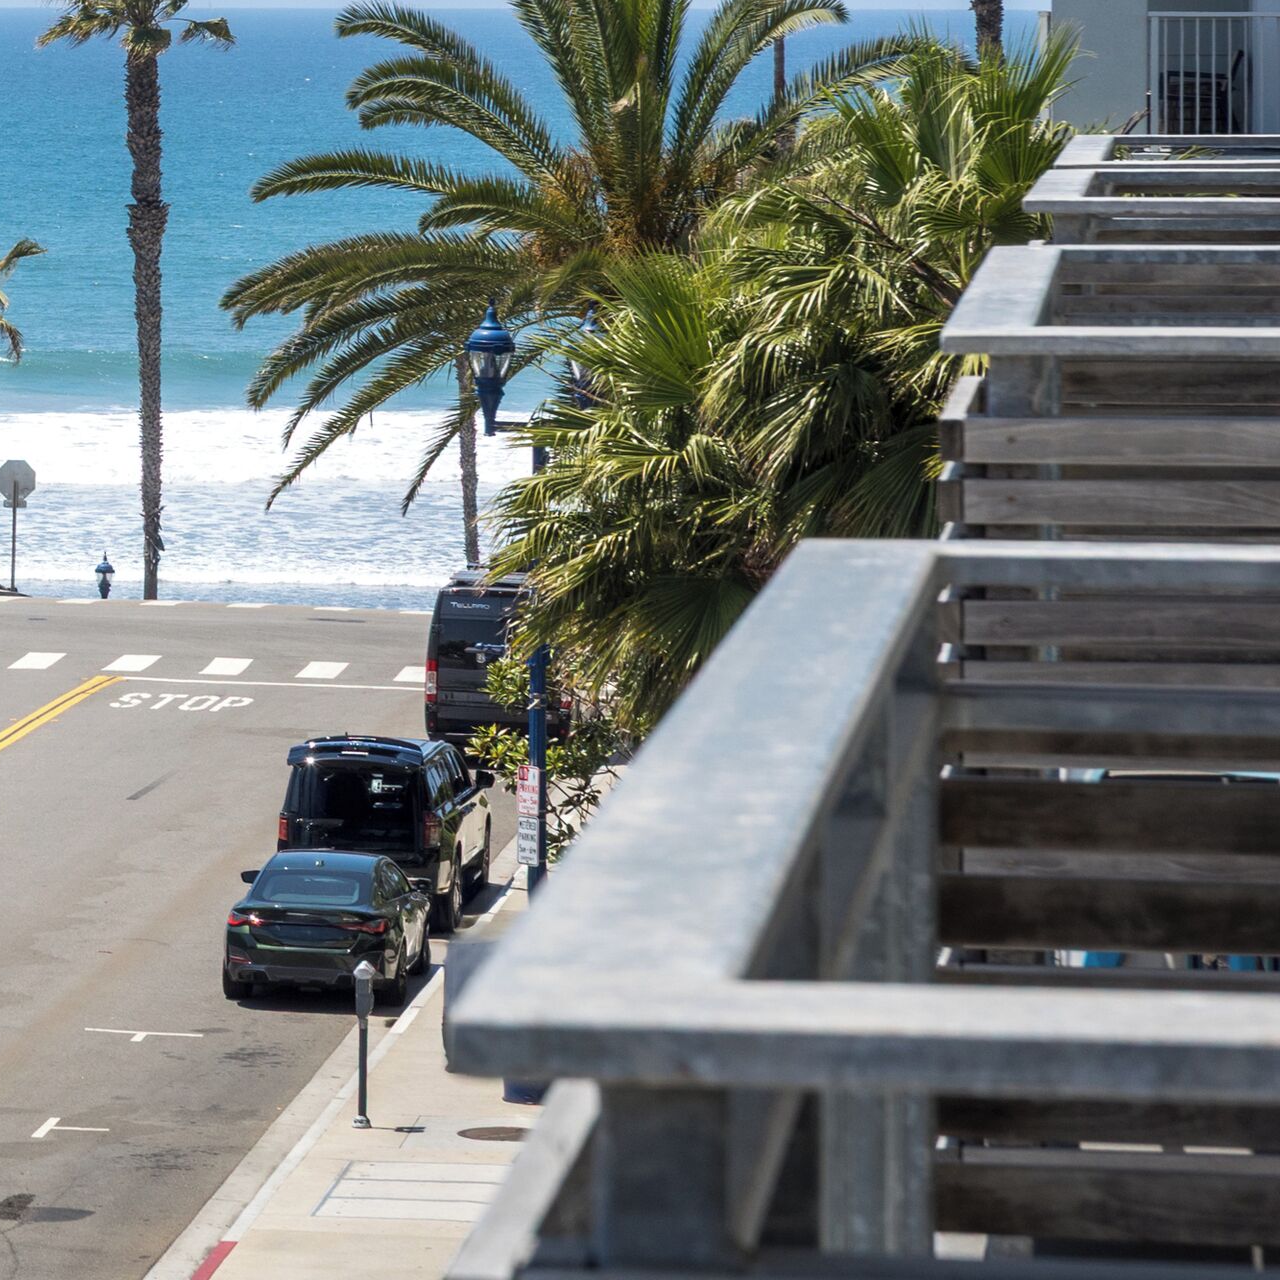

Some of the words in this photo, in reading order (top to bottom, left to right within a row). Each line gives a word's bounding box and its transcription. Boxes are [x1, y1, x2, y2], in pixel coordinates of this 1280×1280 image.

[109, 692, 255, 712] STOP
[519, 783, 538, 794] PARKING
[519, 832, 537, 842] PARKING
